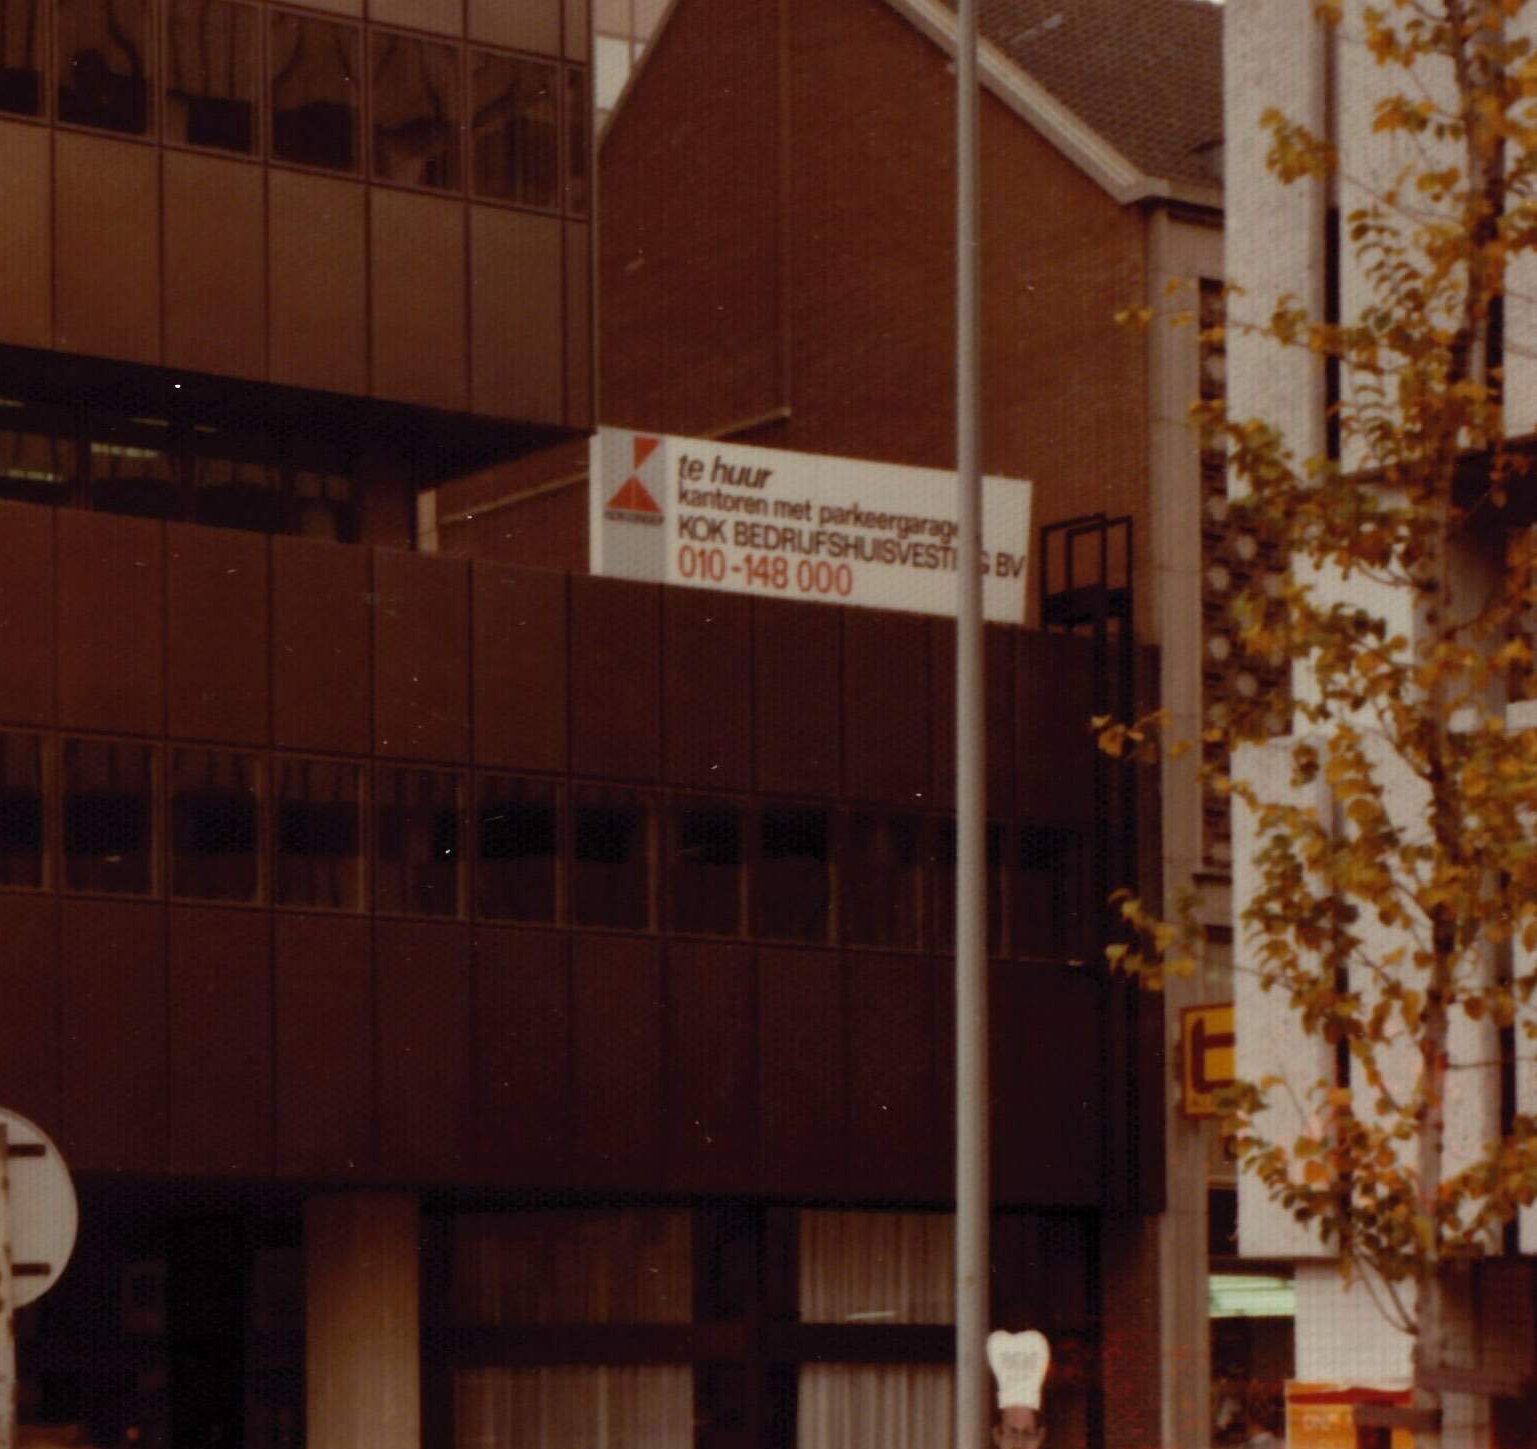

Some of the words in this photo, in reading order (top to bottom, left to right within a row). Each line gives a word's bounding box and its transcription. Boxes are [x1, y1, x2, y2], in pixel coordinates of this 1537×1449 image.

[678, 454, 704, 482] te
[710, 455, 773, 489] huur
[678, 480, 768, 516] kantoren
[774, 498, 812, 522] met
[678, 514, 727, 544] KOK
[734, 520, 990, 575] BEDRIJFSHUISVESTIG
[995, 551, 1025, 578] BV
[796, 559, 854, 596] 000
